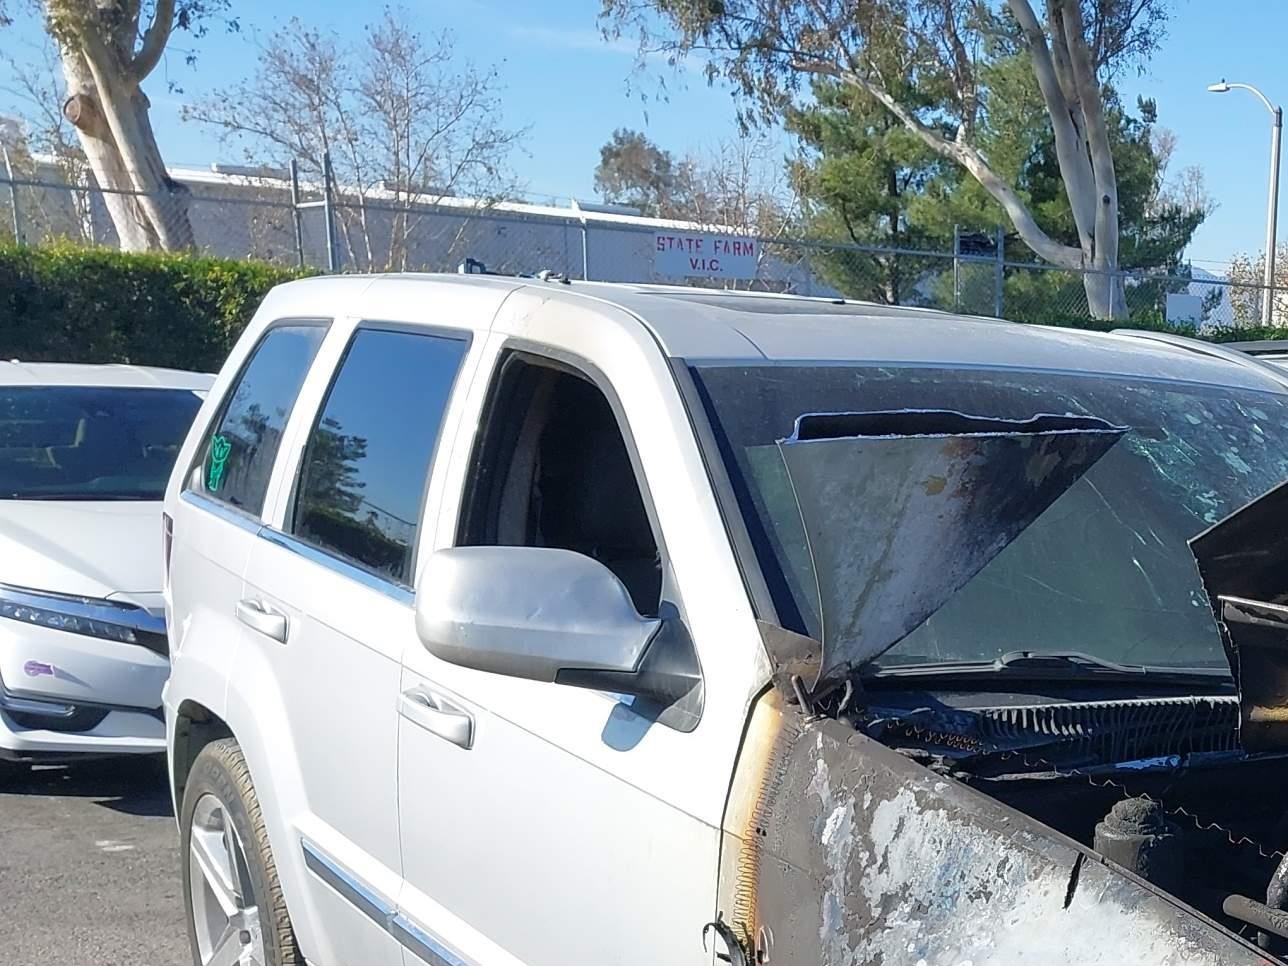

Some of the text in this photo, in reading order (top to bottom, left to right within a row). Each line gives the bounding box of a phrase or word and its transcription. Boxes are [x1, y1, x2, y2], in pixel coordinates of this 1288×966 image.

[656, 236, 754, 257] STATE FARM
[690, 258, 723, 272] V.I.C.
